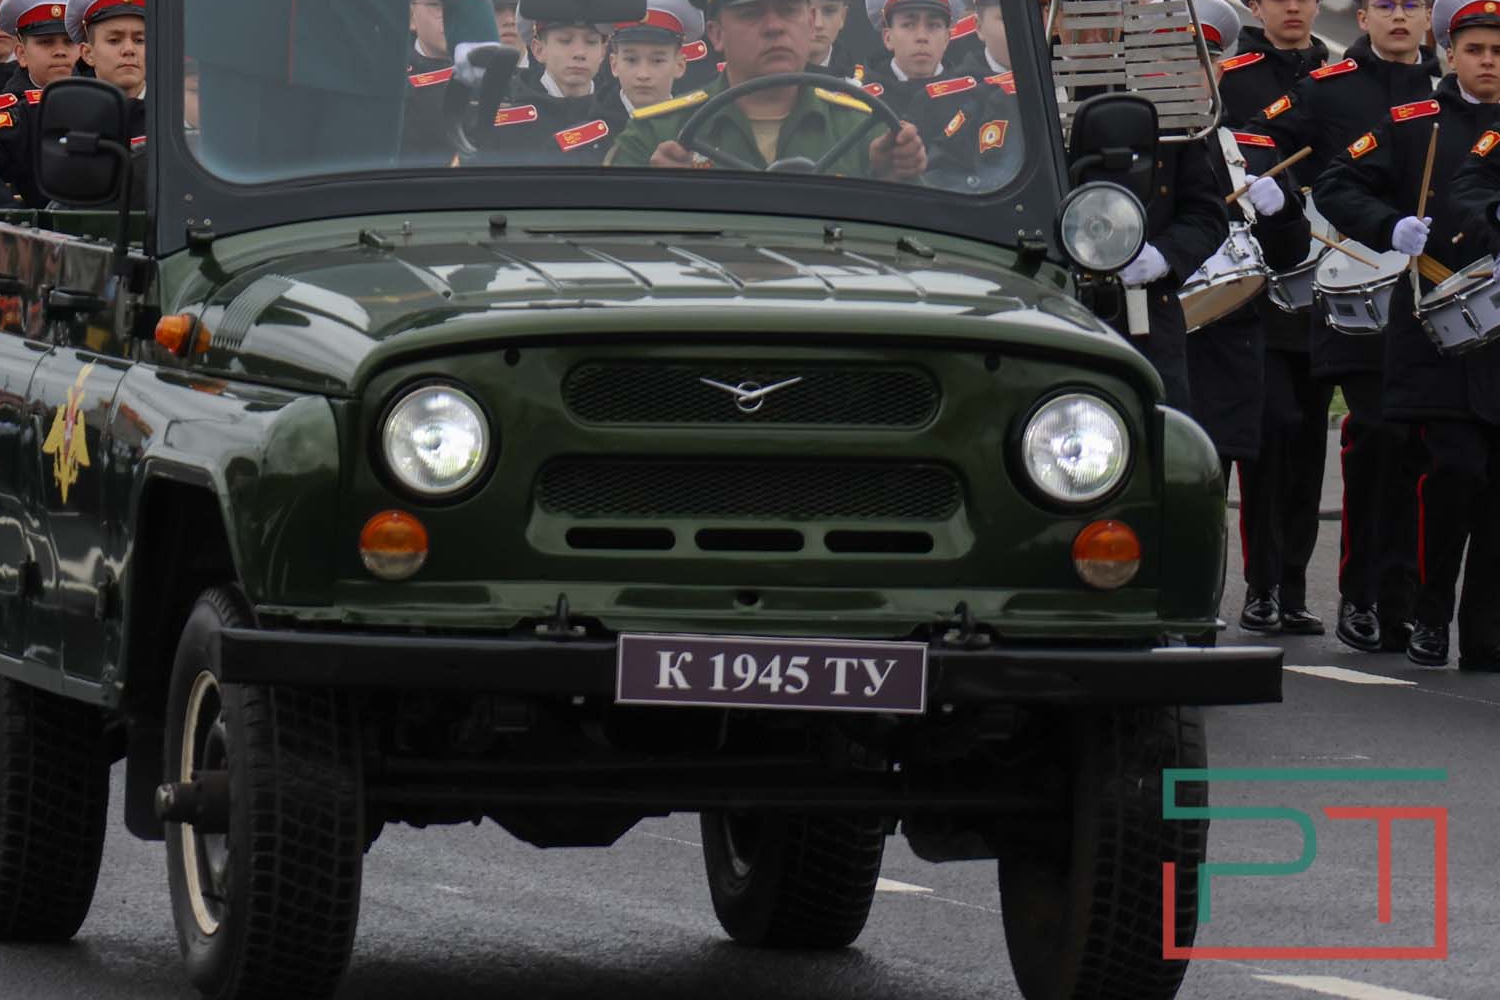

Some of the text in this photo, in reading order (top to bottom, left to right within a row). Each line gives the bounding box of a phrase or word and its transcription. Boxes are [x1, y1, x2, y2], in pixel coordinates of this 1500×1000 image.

[655, 651, 899, 697] К 1945 ТУ
